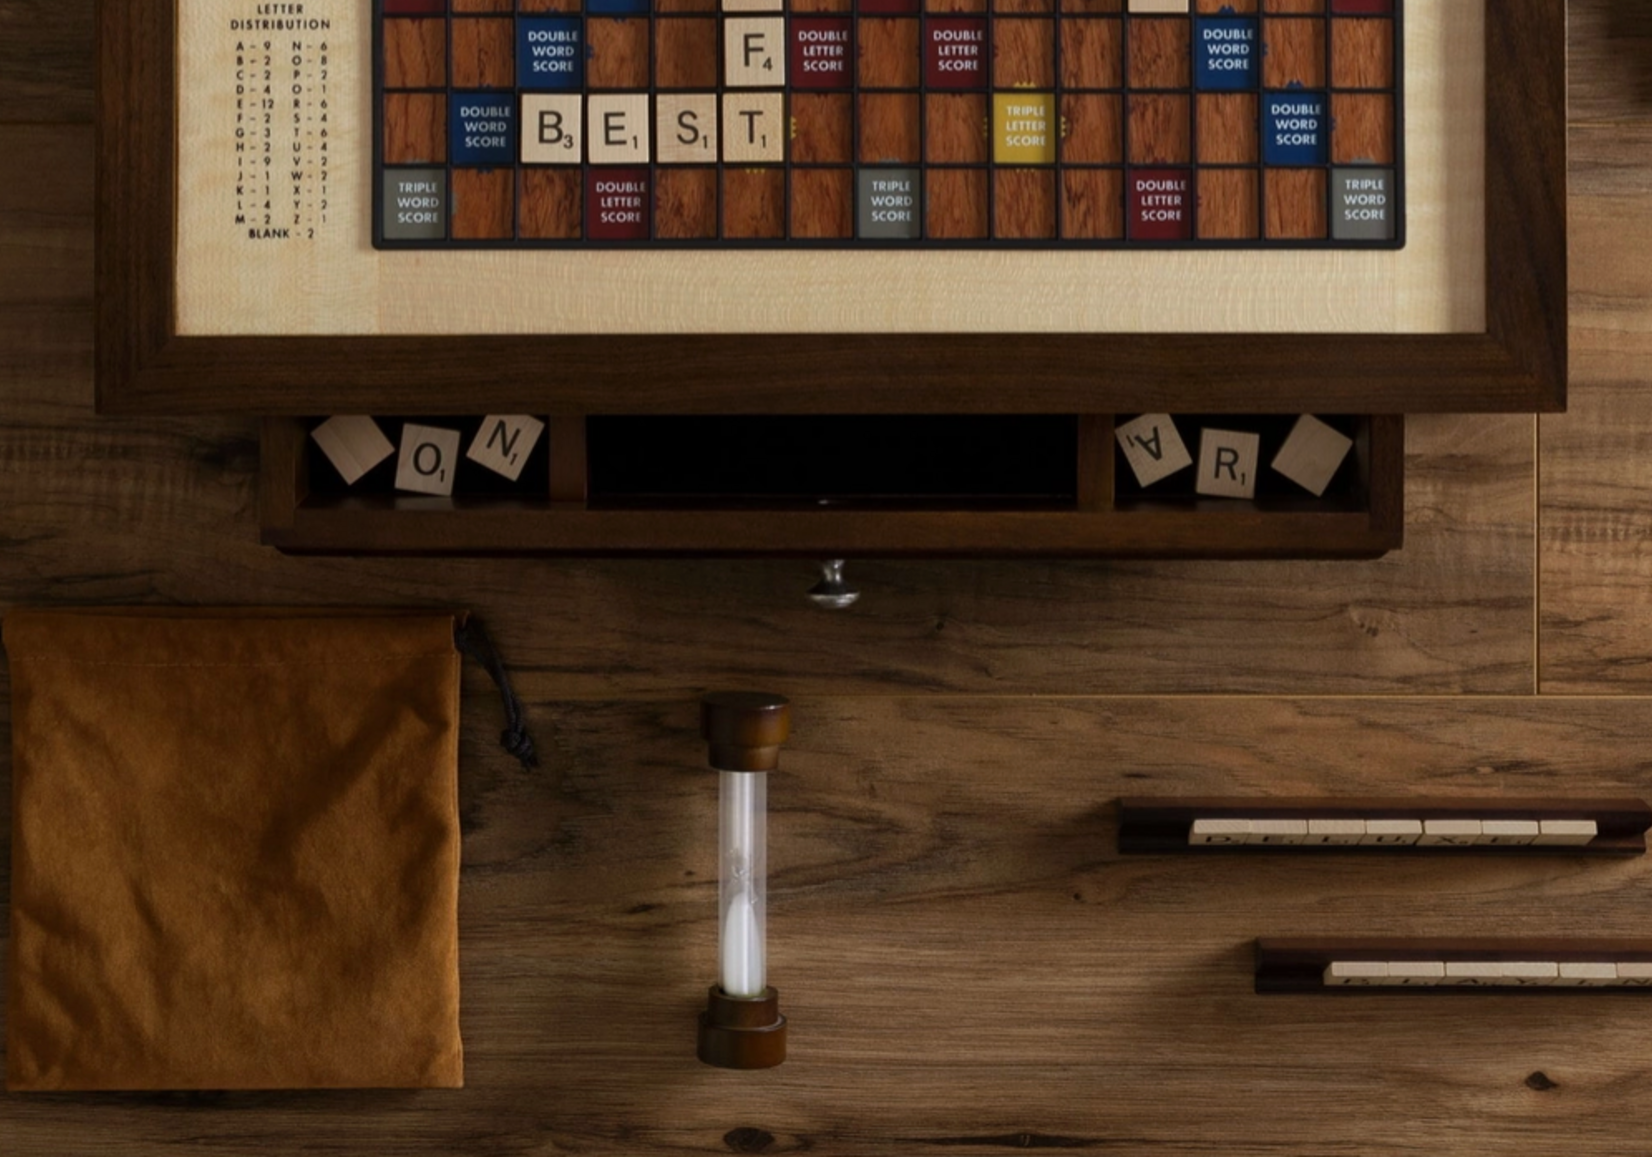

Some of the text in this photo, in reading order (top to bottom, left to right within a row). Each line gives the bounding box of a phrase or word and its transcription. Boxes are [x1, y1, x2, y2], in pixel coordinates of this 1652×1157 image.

[256, 3, 304, 16] LETTER
[230, 19, 331, 31] DISTRIBUTION
[528, 30, 578, 42] DOUBLE
[799, 30, 847, 42] DOUBLE
[934, 29, 982, 42] DOUBLE
[1204, 28, 1253, 40] DOUBLE
[532, 45, 574, 57] WORD
[804, 45, 843, 57] LETTER
[939, 44, 978, 56] LETTER
[1208, 43, 1249, 55] WORD
[533, 60, 573, 72] SCORE
[804, 60, 843, 72] SCORE
[939, 59, 978, 71] SCORE
[1209, 58, 1249, 70] SCORE
[461, 106, 511, 118] DOUBLE
[1007, 105, 1045, 116] TRIPLE
[1272, 103, 1321, 116] DOUBLE
[465, 121, 506, 133] WORD
[1006, 120, 1046, 132] LETTER
[1276, 118, 1317, 130] WORD
[466, 136, 506, 148] SCORE
[1006, 135, 1046, 147] SCORE
[1276, 133, 1317, 145] SCORE
[399, 182, 436, 193] TRIPLE
[596, 181, 645, 193] DOUBLE
[873, 180, 910, 192] TRIPLE
[1137, 180, 1186, 192] DOUBLE
[1346, 179, 1384, 190] TRIPLE
[398, 197, 438, 208] WORD
[601, 196, 641, 208] LETTER
[871, 195, 912, 207] WORD
[1142, 194, 1182, 206] LETTER
[1344, 193, 1385, 206] WORD
[398, 211, 437, 224] SCORE
[601, 211, 641, 223] SCORE
[872, 210, 911, 222] SCORE
[1142, 209, 1182, 221] SCORE
[1345, 208, 1385, 221] SCORE
[248, 228, 290, 240] BLANK
